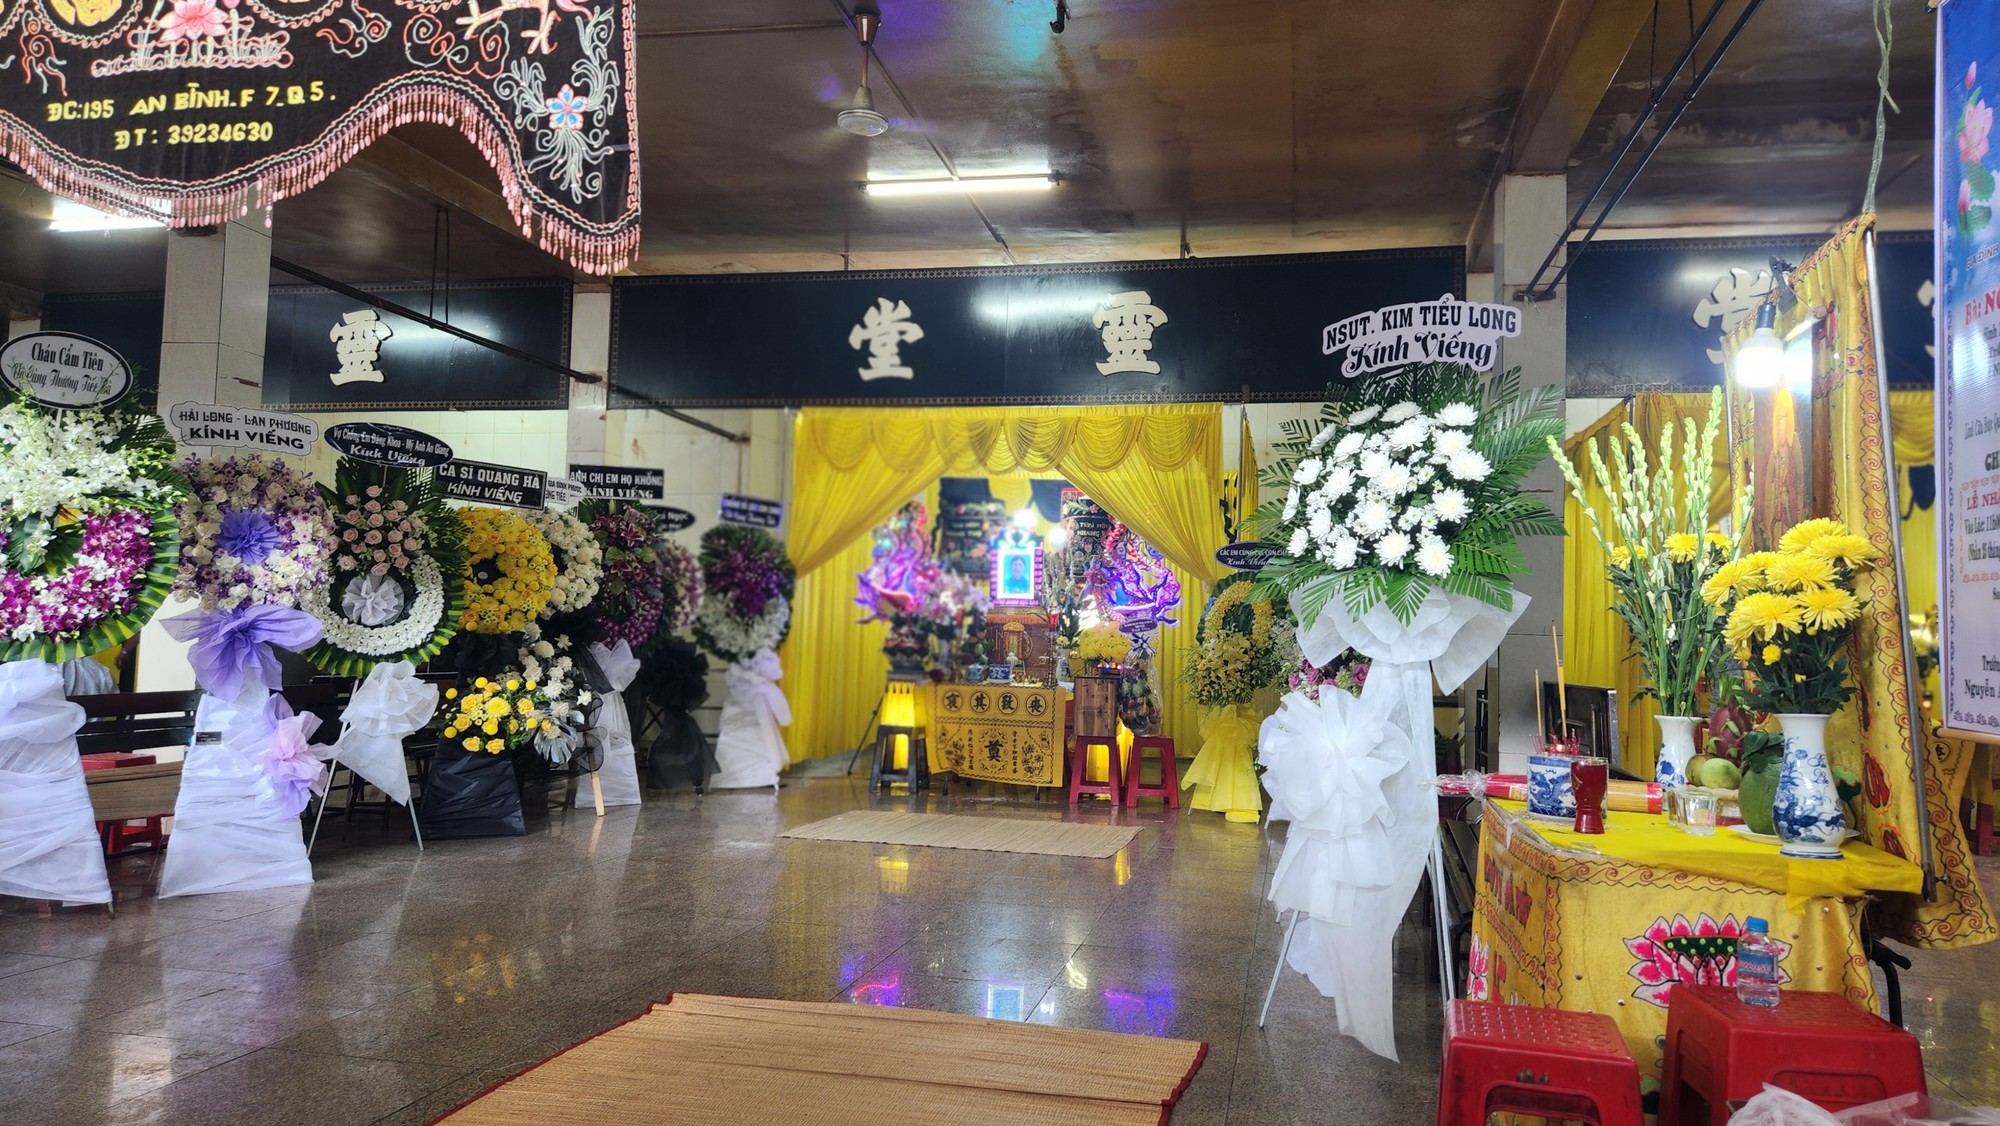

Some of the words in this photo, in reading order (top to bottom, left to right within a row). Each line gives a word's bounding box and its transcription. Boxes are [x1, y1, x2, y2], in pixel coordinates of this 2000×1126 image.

[129, 94, 167, 116] AN
[168, 121, 274, 145] 39234630
[1326, 315, 1375, 350] NSUT.
[1381, 307, 1413, 331] KIM
[1419, 297, 1462, 326] TIỂU
[1468, 305, 1516, 333] LONG
[848, 296, 925, 381] 堂
[31, 342, 57, 364] Cháu
[58, 343, 80, 368] Cẩm
[82, 350, 104, 371] Tiên
[1345, 334, 1410, 373] Kính
[1414, 331, 1493, 368] Viếng
[179, 408, 199, 421] HẢI
[202, 411, 233, 423] LONG
[244, 414, 266, 427] LAN
[269, 418, 311, 435] PHƯƠNG
[189, 425, 240, 440] KÍNH
[245, 429, 304, 449] VIẾNG
[350, 444, 383, 458] Kính
[439, 464, 456, 478] CA
[460, 466, 473, 480] SĨ
[477, 470, 519, 486] QUANG
[523, 475, 540, 489] HÀ
[589, 472, 603, 486] CHỊ
[605, 474, 619, 485] EM
[620, 475, 632, 487] HỌ
[447, 480, 481, 496] KÍNH
[484, 485, 523, 504] VIẾNG
[585, 485, 614, 497] KÍNH
[618, 485, 653, 499] VIẾNG
[1964, 678, 1996, 700] Nguyễn
